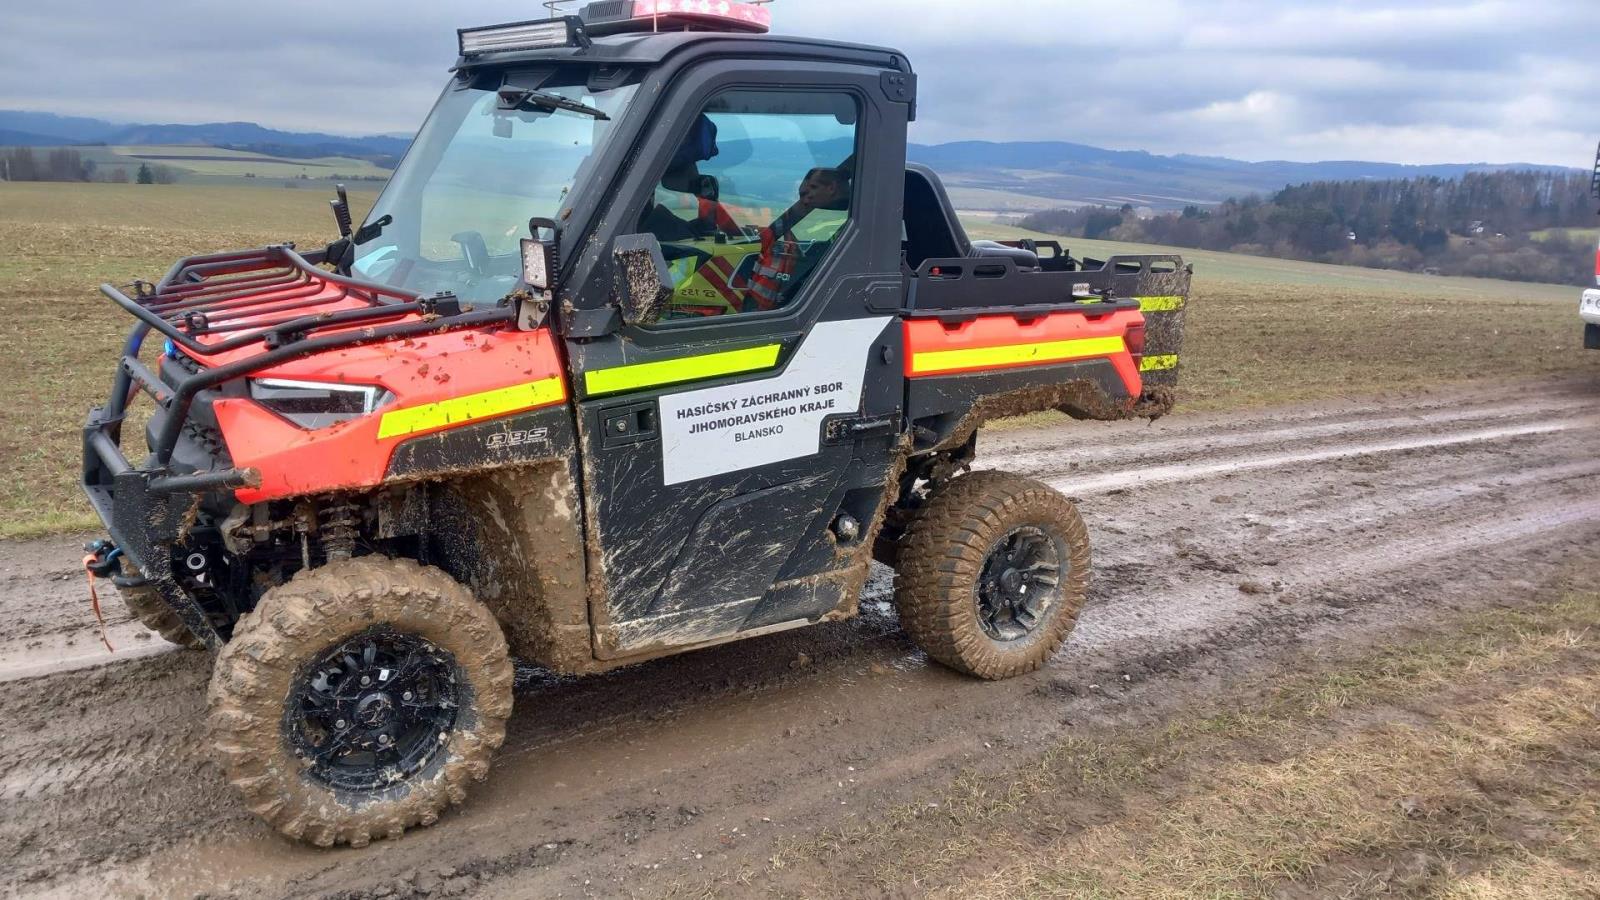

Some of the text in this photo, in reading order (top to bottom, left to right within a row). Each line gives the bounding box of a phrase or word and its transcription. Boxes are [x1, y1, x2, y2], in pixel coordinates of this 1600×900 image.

[677, 381, 844, 420] HASIČSKÝ ZÁCHRANNÝ SBOR
[688, 398, 835, 434] JIHOMORAVSKÉHO KRAJE
[734, 424, 784, 443] BLANSKO
